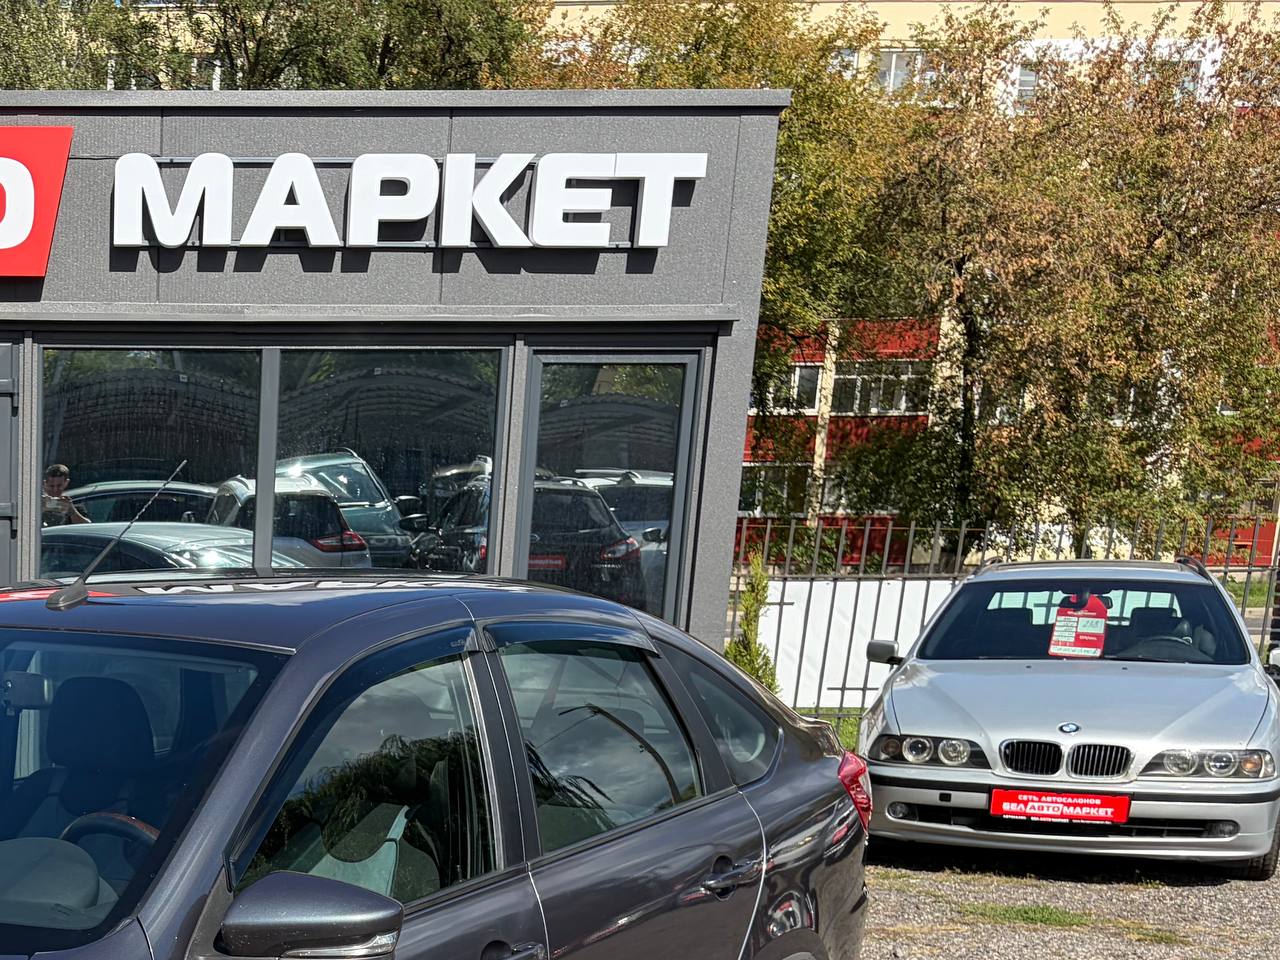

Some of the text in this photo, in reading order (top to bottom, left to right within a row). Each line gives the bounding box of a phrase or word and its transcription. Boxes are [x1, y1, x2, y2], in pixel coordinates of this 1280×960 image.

[113, 152, 708, 248] МАРКЕТ
[1018, 794, 1102, 805] СЕТЬ АВТОСАЛОНОВ
[1002, 802, 1115, 817] БЕЛ АВТО МАРКЕТ
